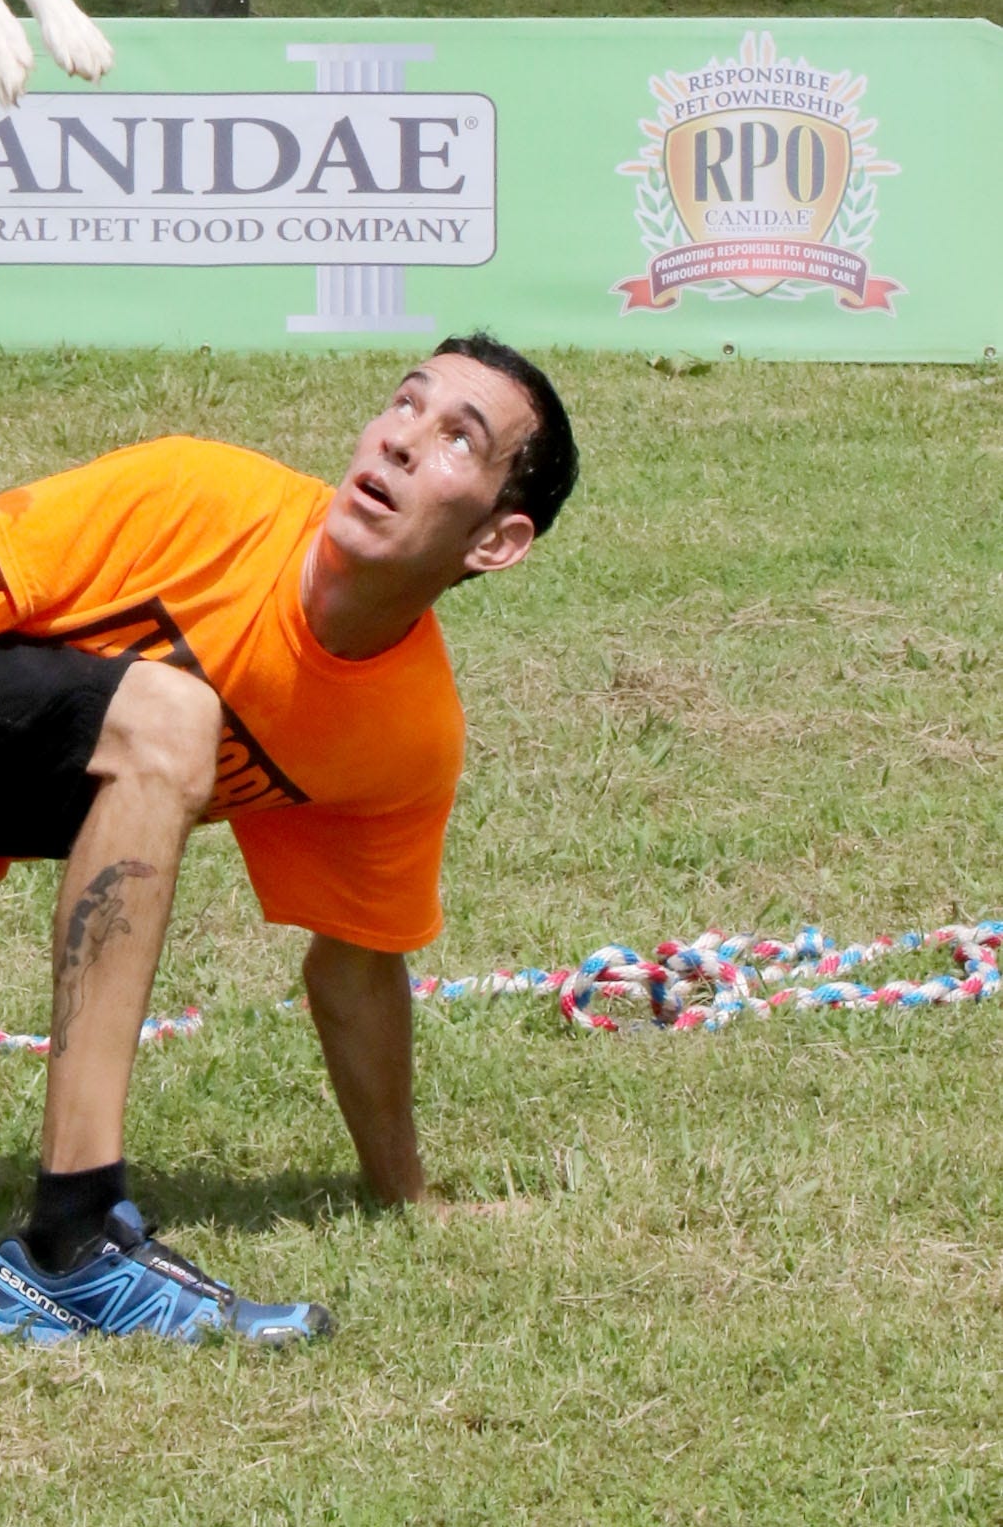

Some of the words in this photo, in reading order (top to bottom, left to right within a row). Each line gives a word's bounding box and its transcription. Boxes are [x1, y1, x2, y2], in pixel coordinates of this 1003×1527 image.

[688, 68, 830, 93] RESPONSIBLE
[673, 94, 710, 120] PET
[715, 88, 845, 119] OWNERSHIP
[694, 121, 826, 203] RPO
[68, 217, 140, 243] PET
[150, 217, 265, 243] FOOD
[276, 217, 471, 244] COMPANY
[704, 209, 810, 226] CANIDAE
[655, 248, 715, 272] PROMOTING
[717, 243, 781, 257] RESPONSIBLE
[783, 244, 800, 256] PET
[802, 248, 862, 272] OWNERSHIP
[660, 265, 708, 285] THROUGH
[710, 260, 752, 274] PROPER
[752, 259, 806, 272] NUTRITION
[808, 263, 830, 277] AND
[831, 269, 857, 286] CARE
